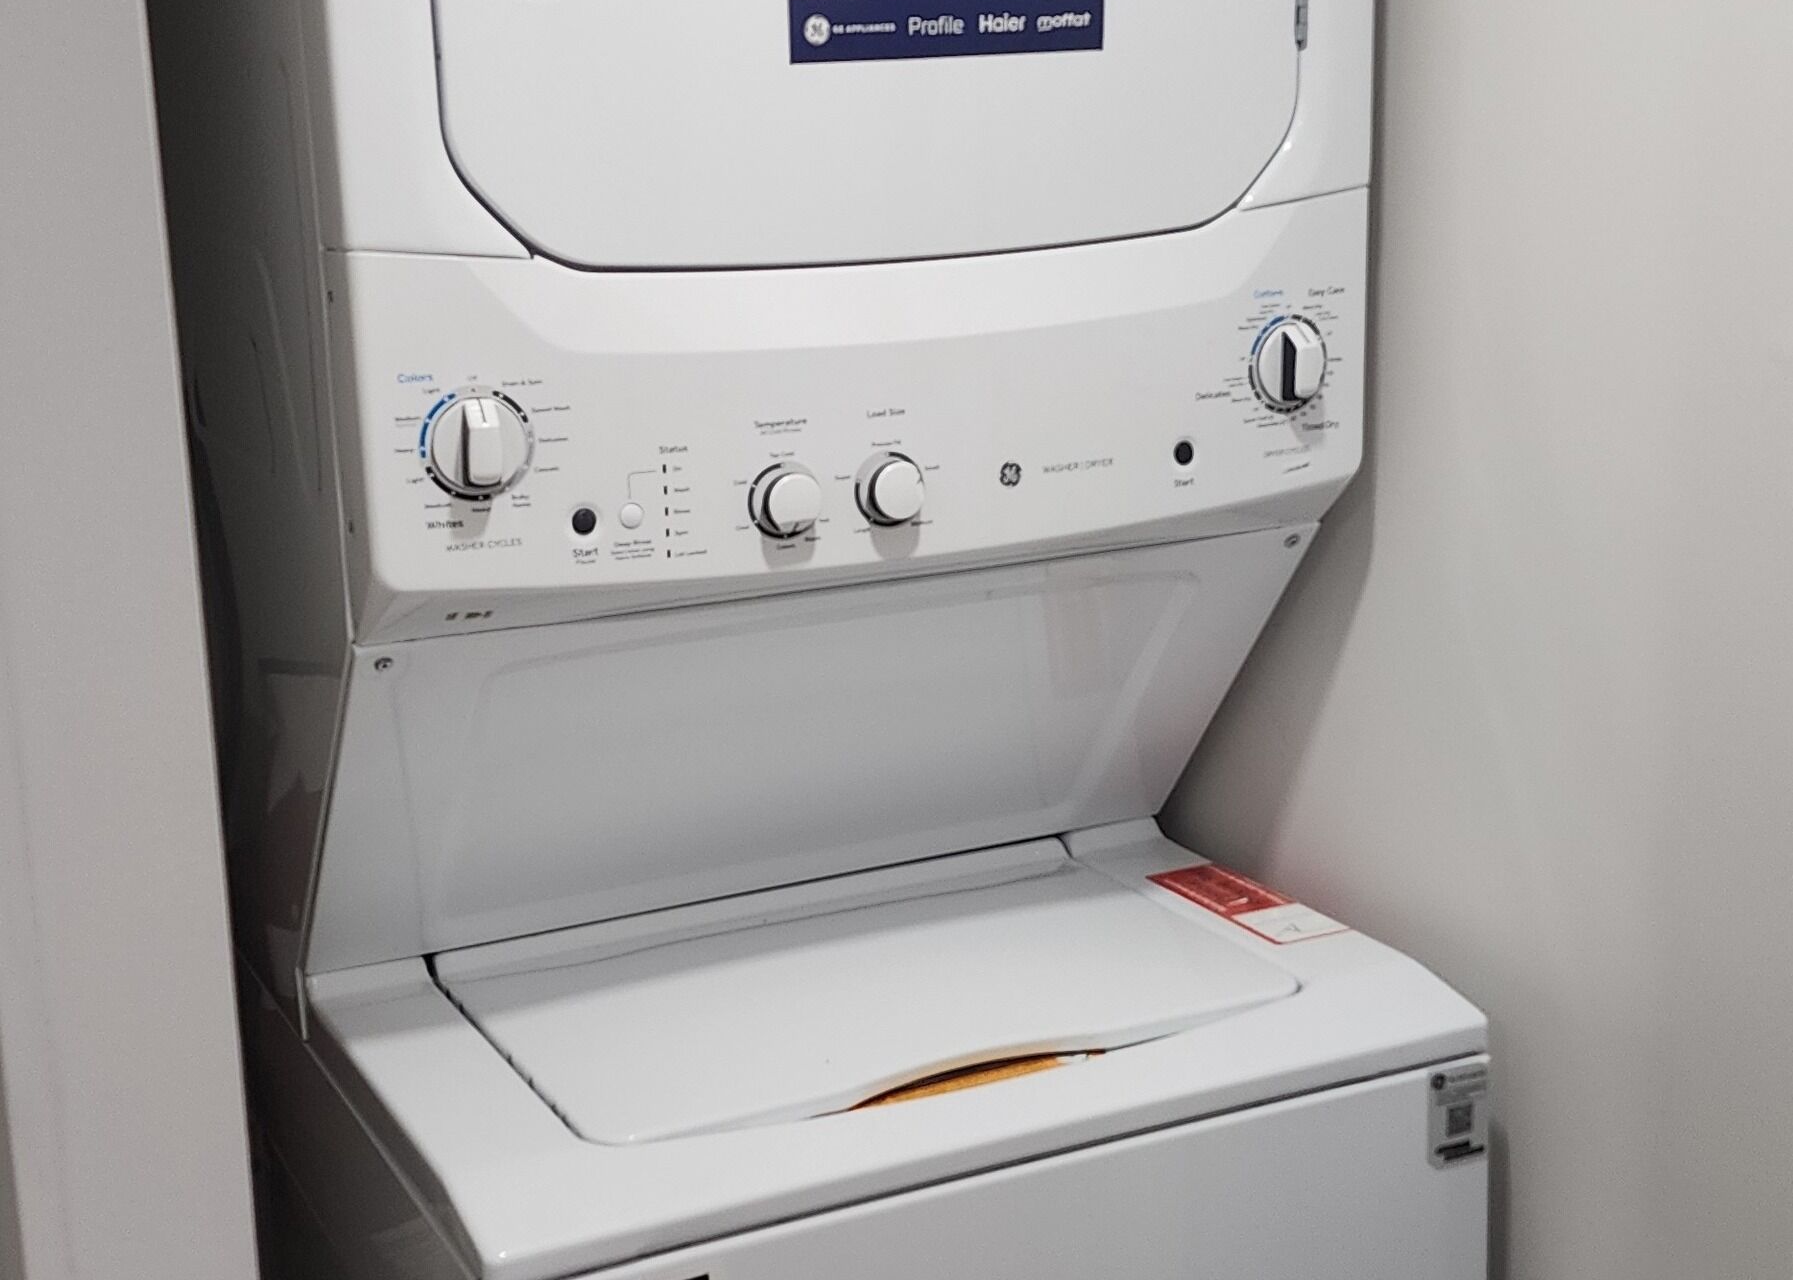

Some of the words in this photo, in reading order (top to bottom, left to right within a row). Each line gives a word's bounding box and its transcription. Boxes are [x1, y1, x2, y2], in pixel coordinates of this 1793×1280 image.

[845, 21, 897, 35] APPLIANCES
[907, 15, 965, 37] Profile
[978, 13, 1027, 35] Haier
[1036, 11, 1092, 33] moffat
[397, 373, 434, 384] Colors
[754, 418, 808, 429] Temperature
[1173, 477, 1195, 488] Start
[446, 541, 485, 552] WASHER
[487, 537, 523, 550] CYCLES
[572, 547, 599, 559] Start
